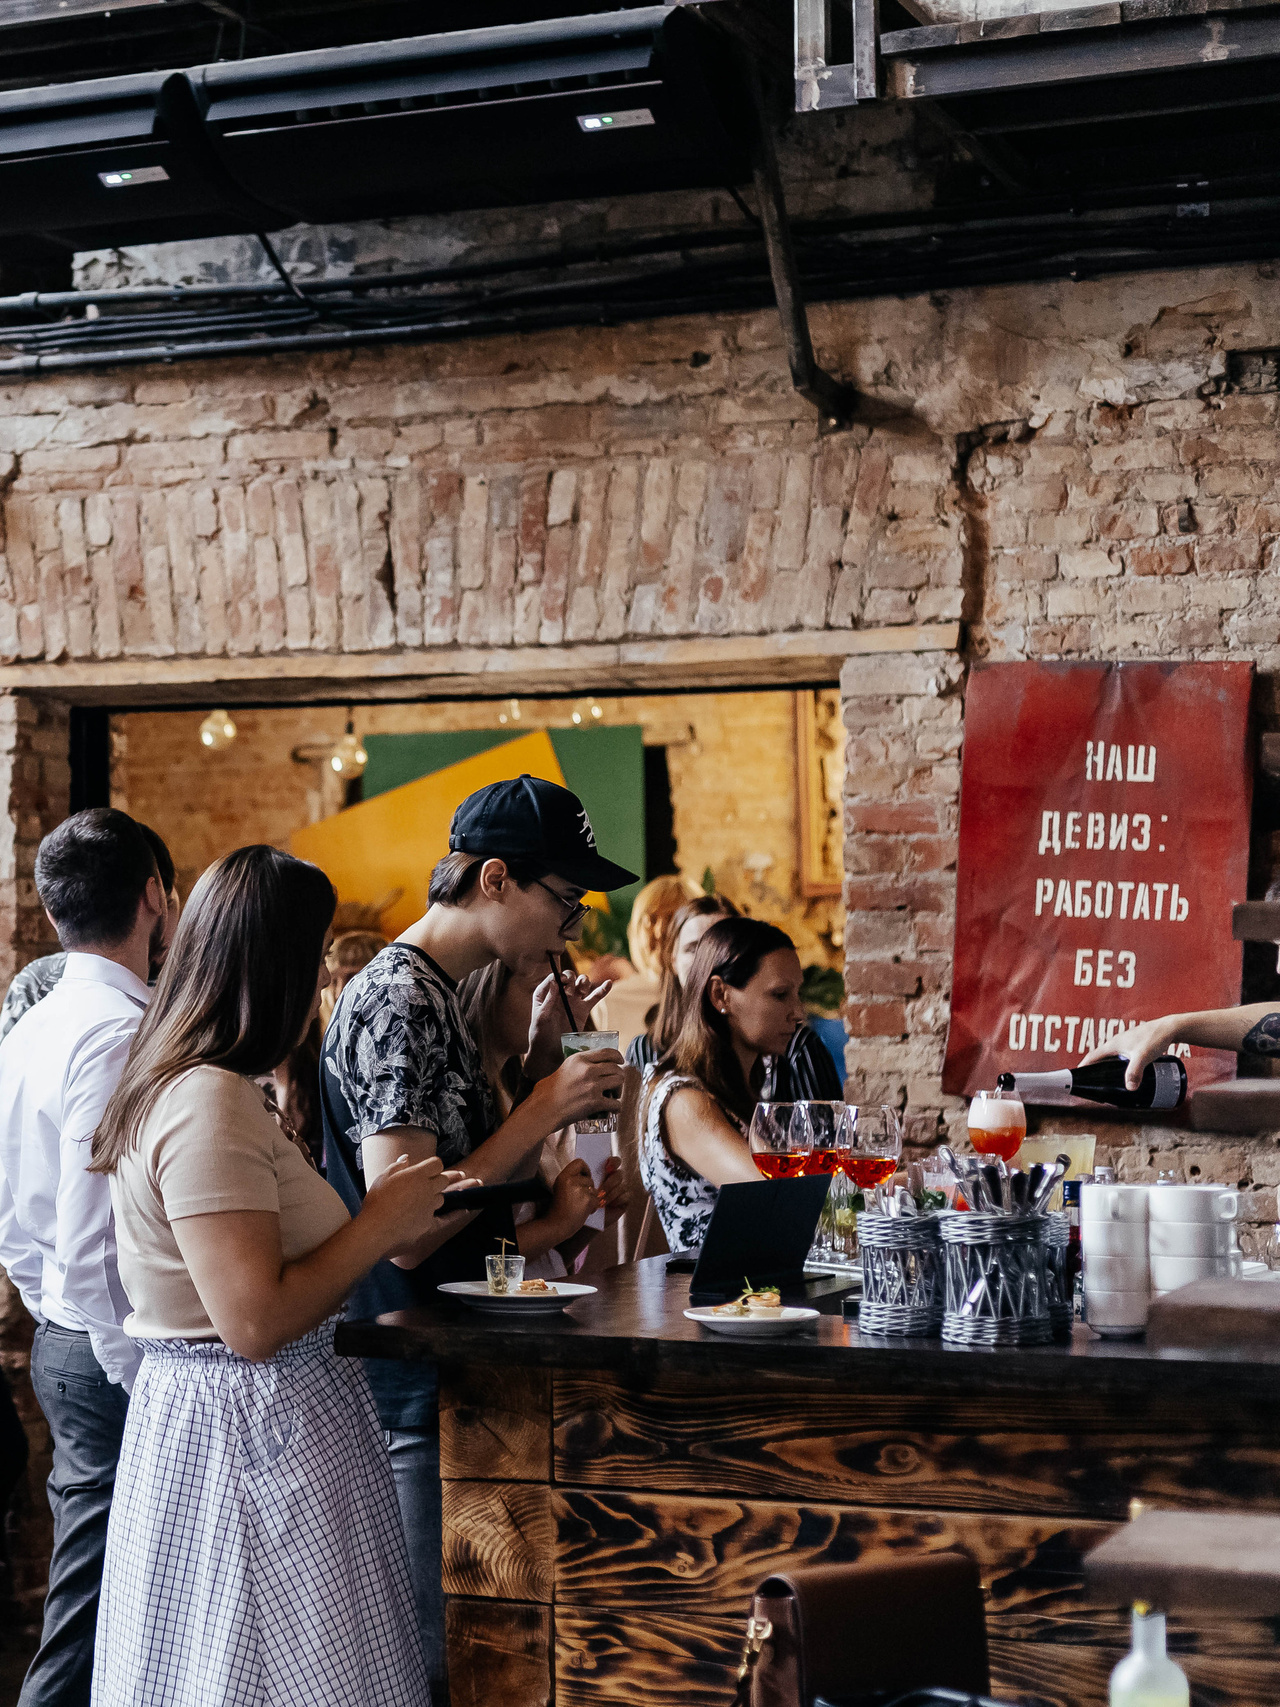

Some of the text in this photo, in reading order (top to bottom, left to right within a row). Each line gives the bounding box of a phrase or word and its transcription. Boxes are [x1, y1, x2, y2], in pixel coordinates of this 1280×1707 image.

[1086, 741, 1156, 782] НАШ
[1038, 810, 1168, 855] ДЕВИЗ:
[1035, 878, 1189, 922] РАБОТАТЬ
[1073, 949, 1137, 988] БЕЗ
